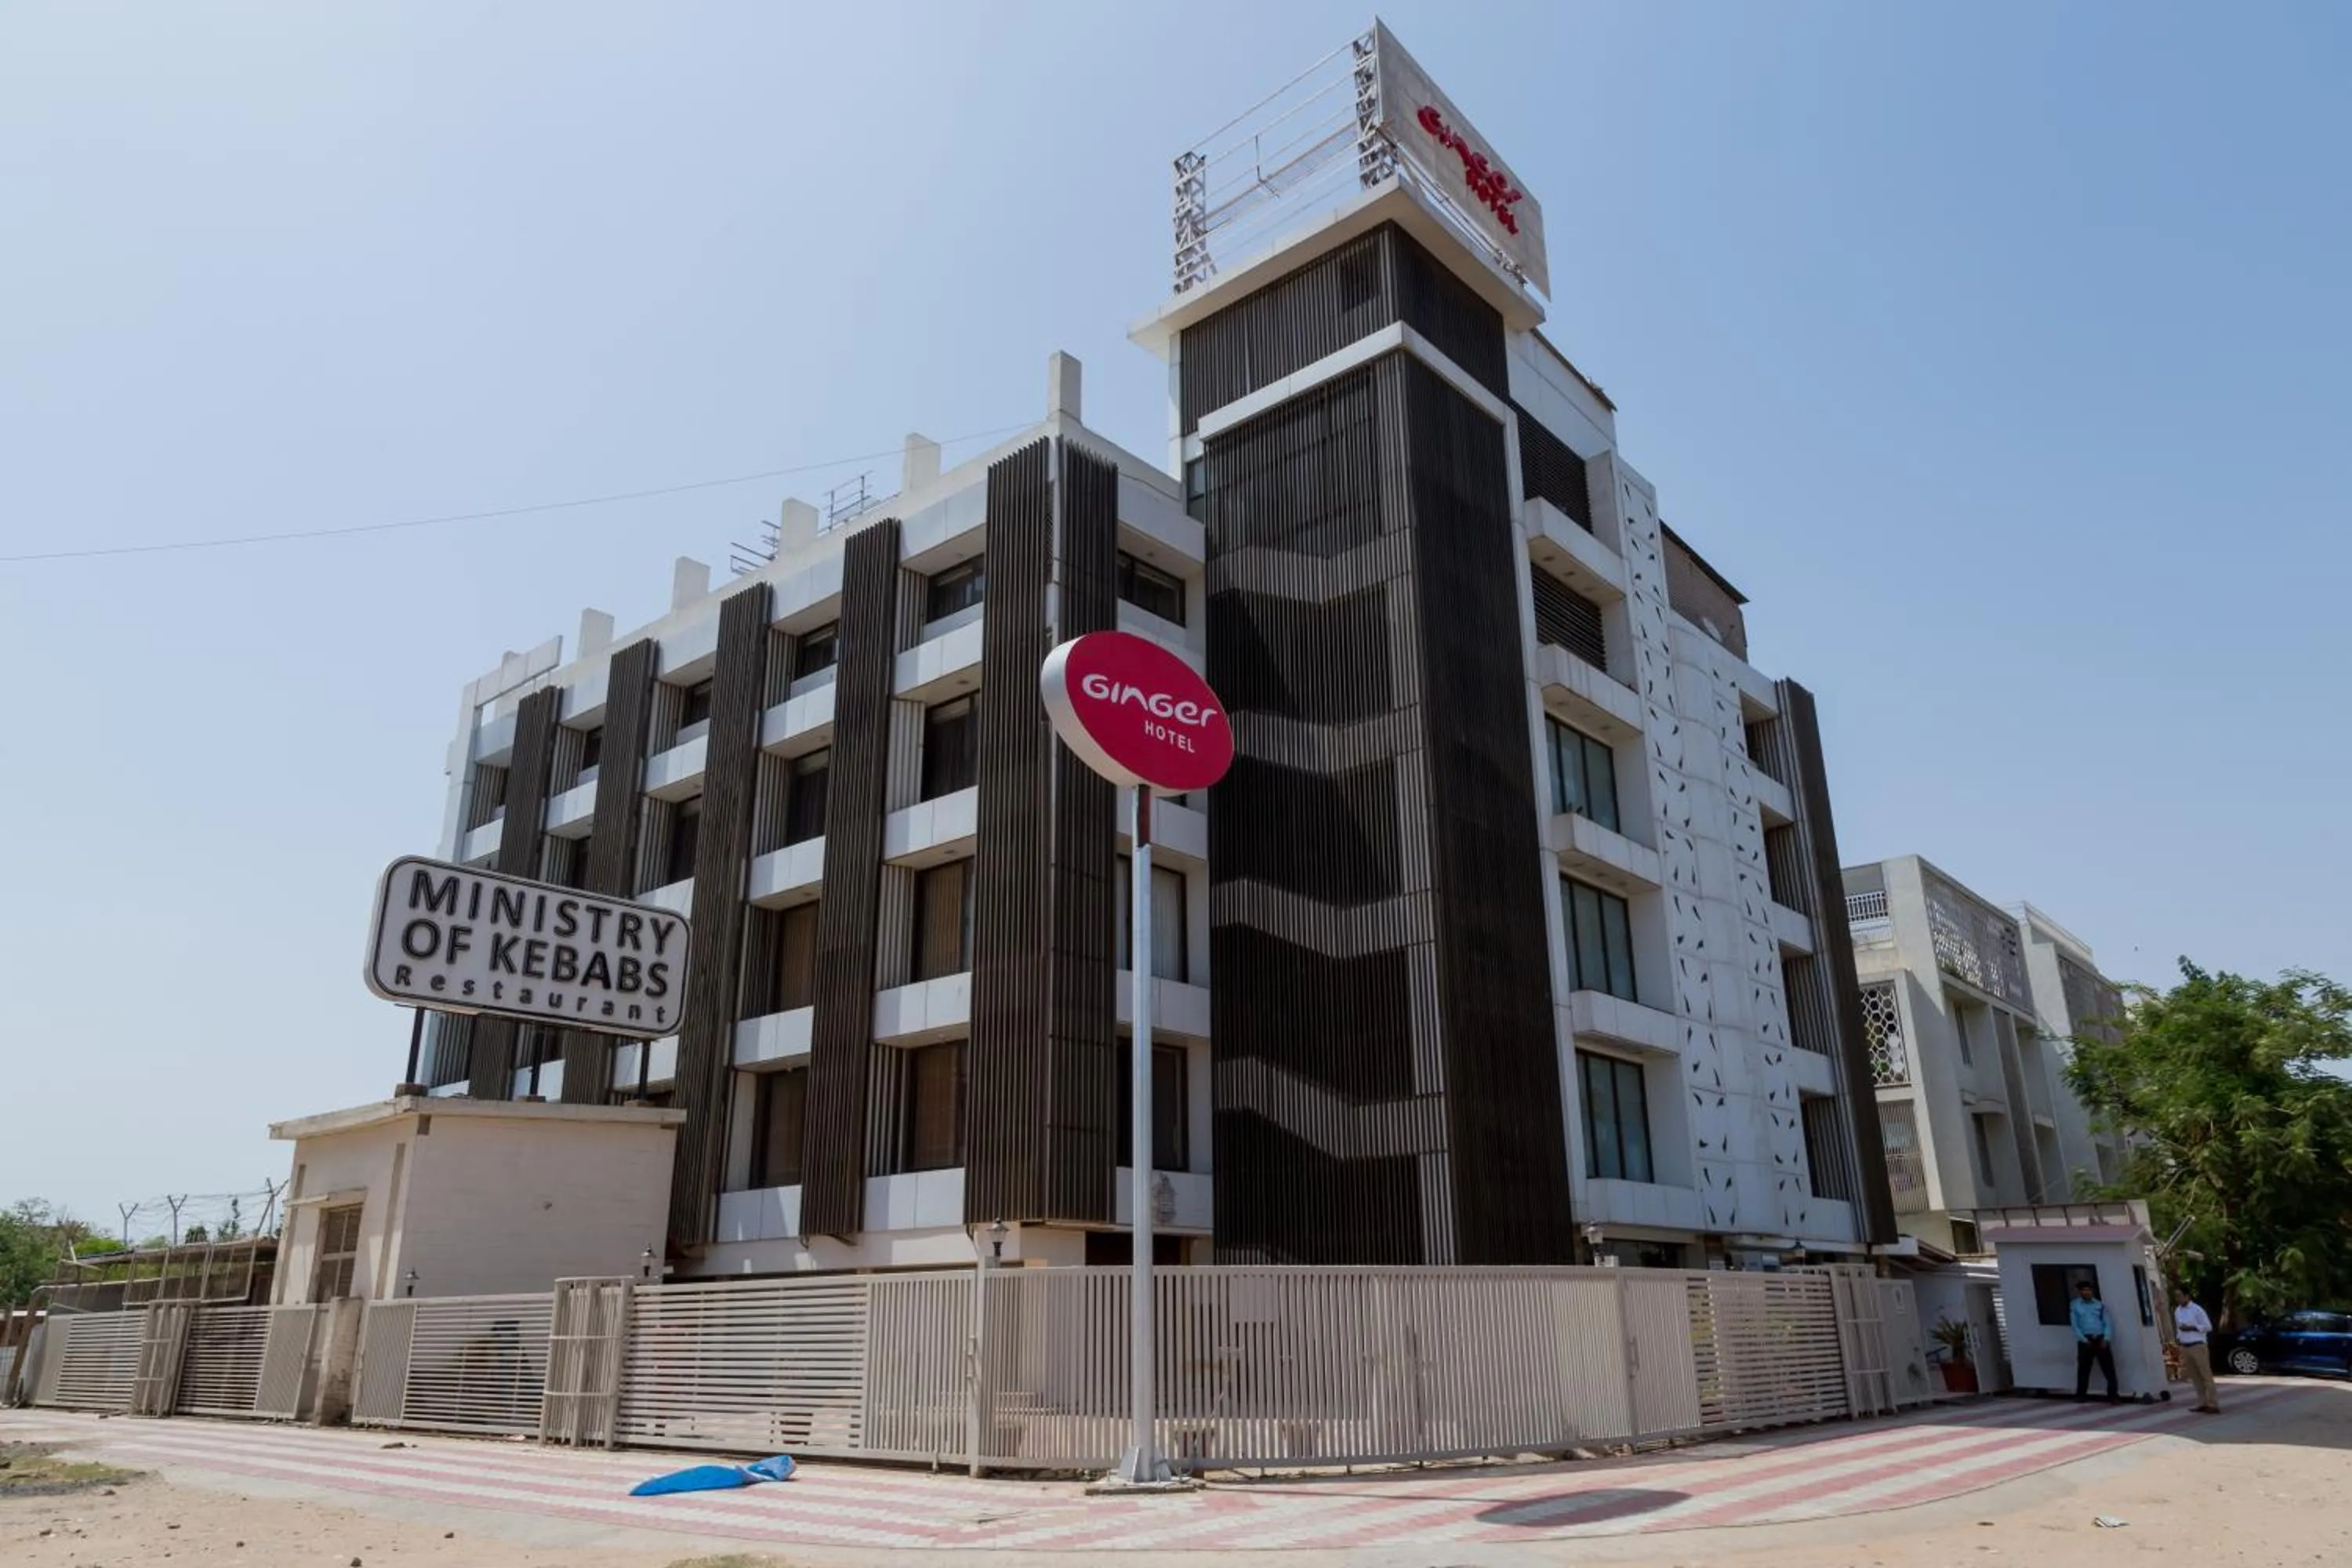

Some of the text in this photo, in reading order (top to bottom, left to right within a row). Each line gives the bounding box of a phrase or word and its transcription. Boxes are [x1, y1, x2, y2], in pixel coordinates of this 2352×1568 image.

[1145, 720, 1196, 753] HOTEL
[408, 869, 676, 955] MINISTRY
[401, 917, 670, 999] OF KEBABS
[394, 964, 666, 1024] Restaurant
